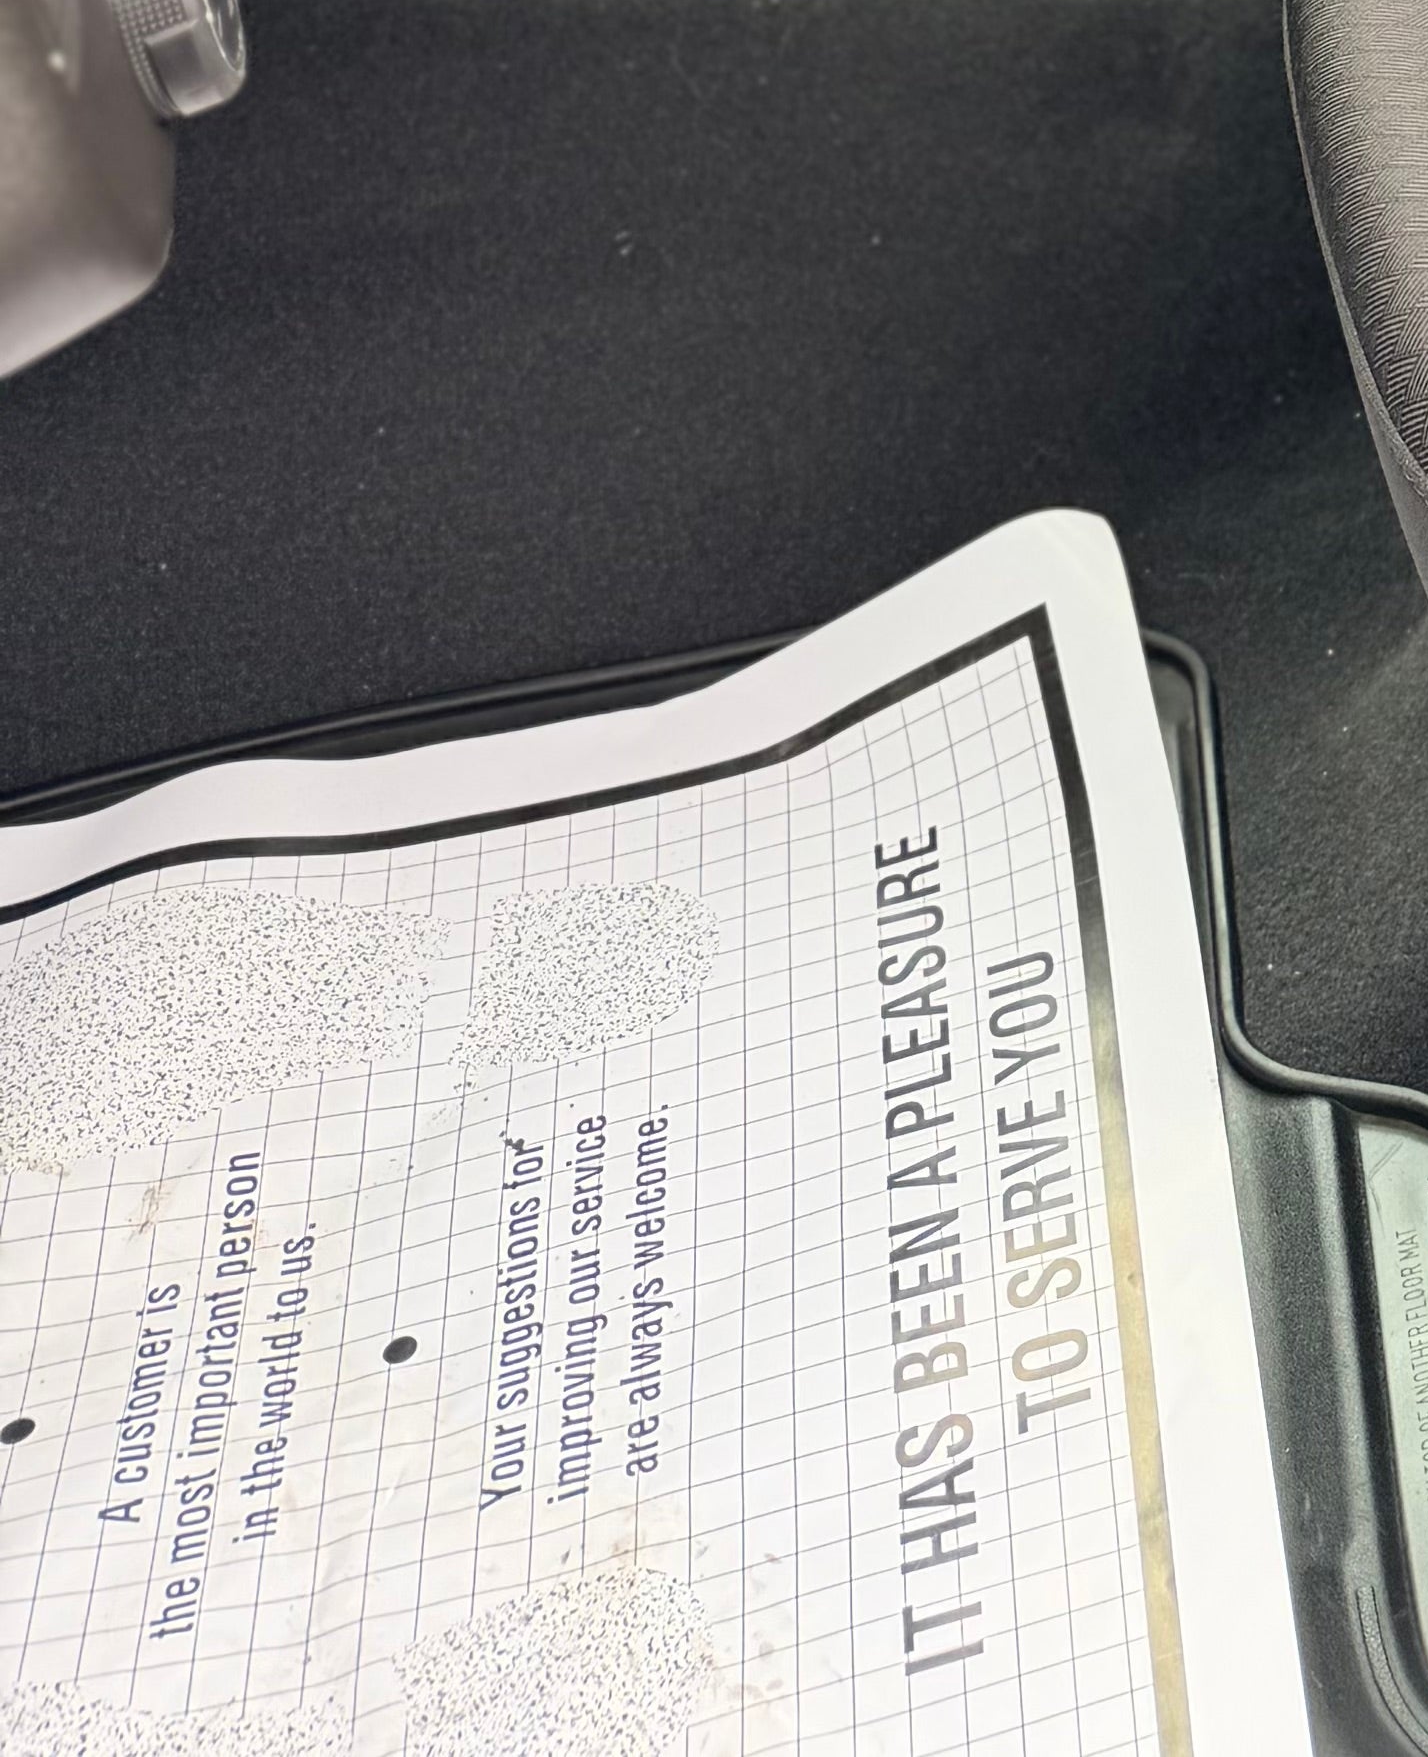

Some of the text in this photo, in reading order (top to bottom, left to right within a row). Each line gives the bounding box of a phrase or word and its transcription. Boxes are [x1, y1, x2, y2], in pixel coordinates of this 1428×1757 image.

[478, 1141, 545, 1511] Your suggestions for
[547, 1114, 608, 1505] improving our service
[619, 1104, 673, 1477] are always welcome.
[874, 825, 984, 1676] IT HAS BEEN A PLEASURE
[987, 951, 1092, 1435] TO SERVE YOU
[1395, 1228, 1420, 1262] MAT
[1400, 1264, 1428, 1321] FLOOR
[98, 1283, 181, 1524] A customer is
[149, 1151, 261, 1640] the most important person
[232, 1222, 317, 1544] in the world to us.
